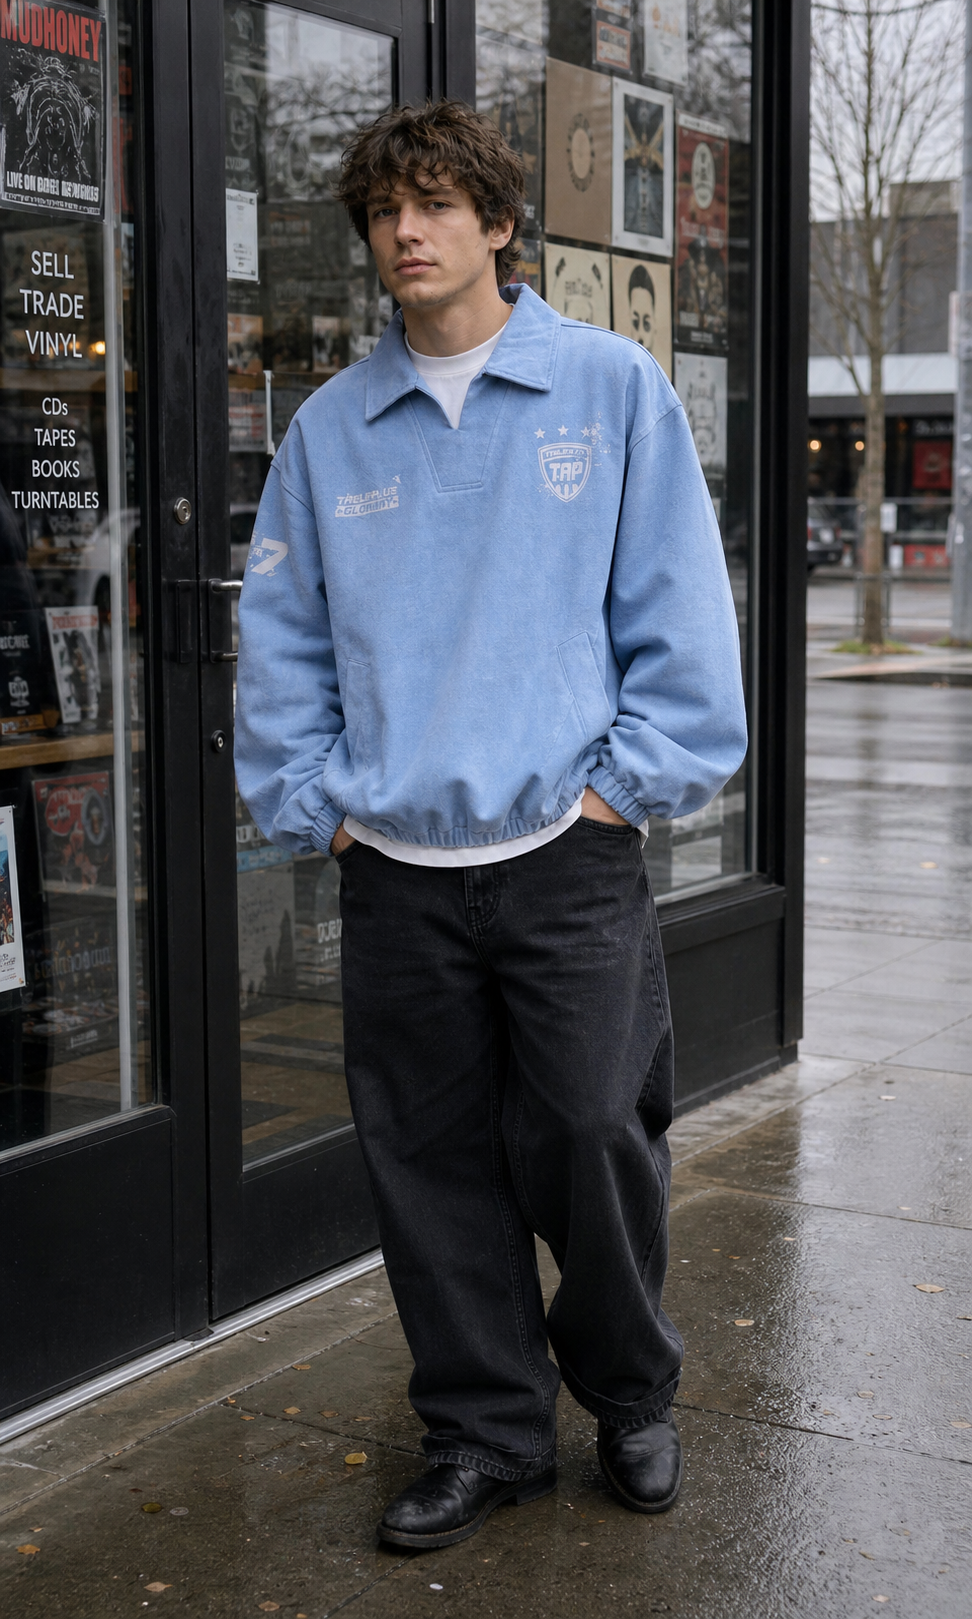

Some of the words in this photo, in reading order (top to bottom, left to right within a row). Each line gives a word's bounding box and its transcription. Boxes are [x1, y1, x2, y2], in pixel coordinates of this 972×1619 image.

[0, 0, 102, 62] MUDHONEY
[6, 170, 23, 189] LIVE
[31, 250, 75, 280] SELL
[19, 288, 85, 320] TRADE
[25, 329, 83, 359] VINYL
[41, 396, 69, 416] CDs
[34, 427, 76, 448] TAPES
[31, 459, 81, 478] BOOKS
[549, 461, 583, 482] TAP
[11, 490, 99, 510] TURNTABLES
[251, 537, 289, 575] 7
